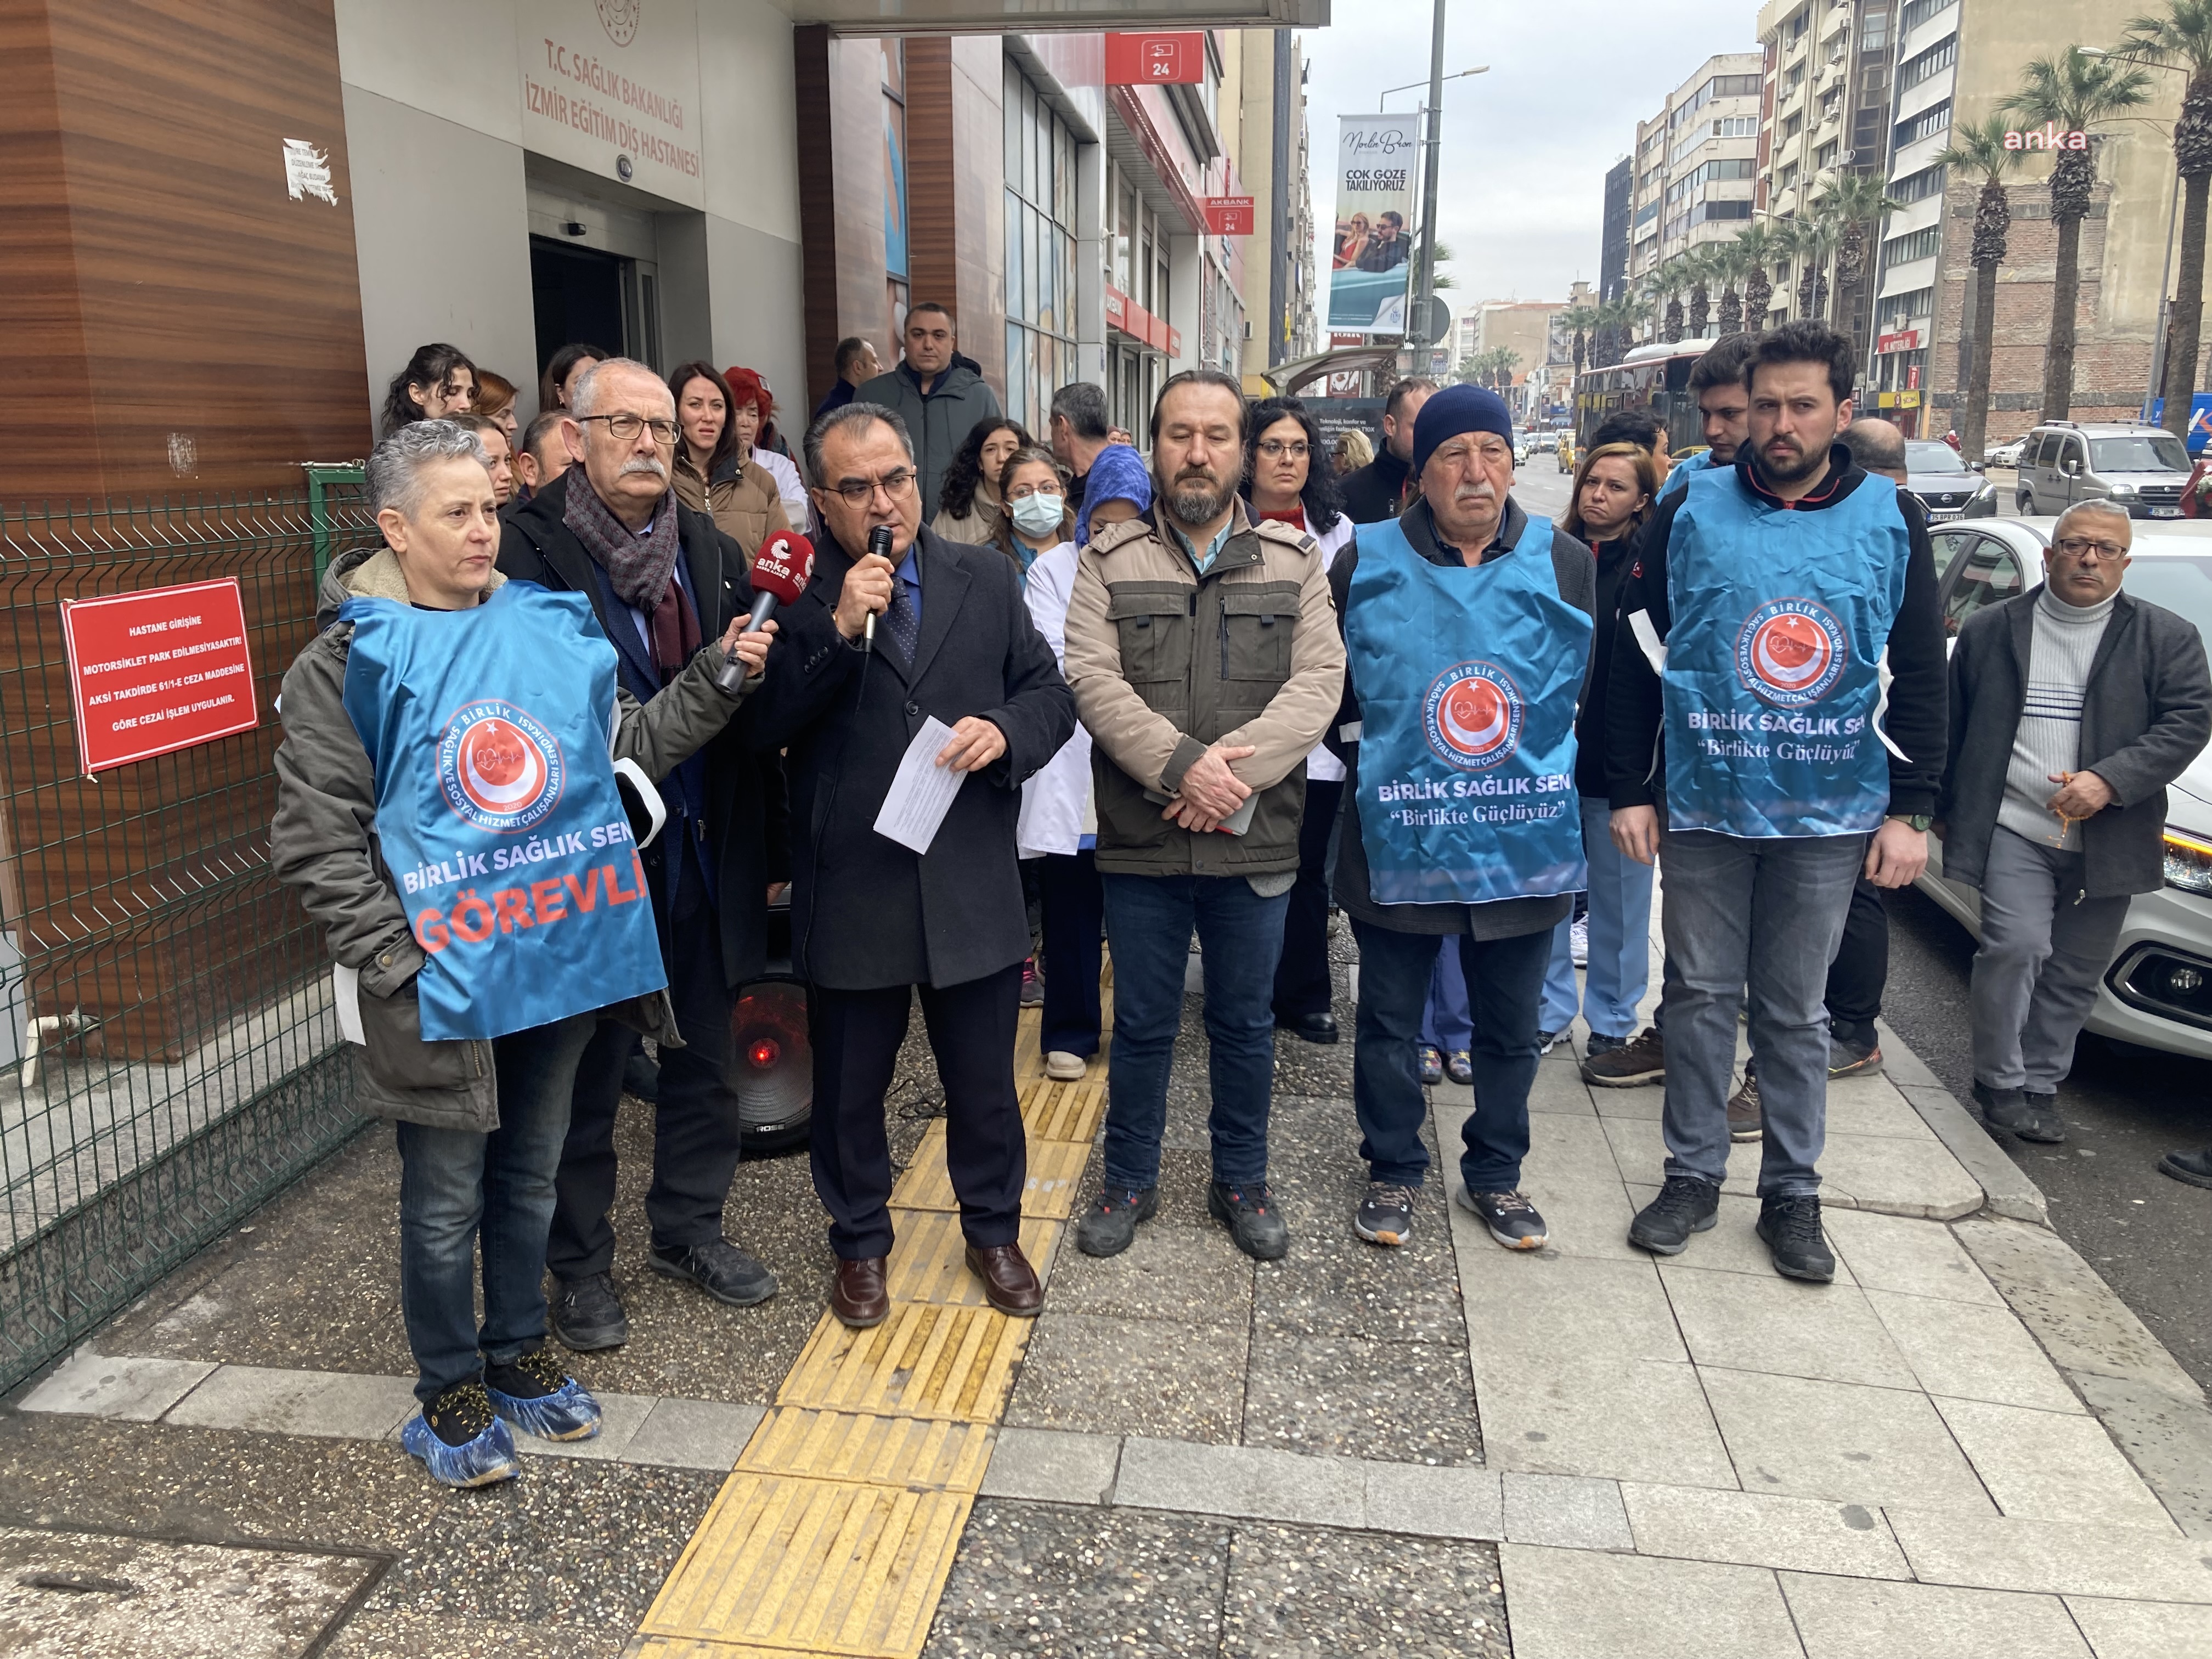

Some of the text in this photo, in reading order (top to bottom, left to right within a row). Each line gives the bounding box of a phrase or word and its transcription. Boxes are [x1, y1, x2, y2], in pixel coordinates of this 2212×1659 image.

[545, 38, 683, 131] T.C. SAĞLIK BAKANLIĞI
[1153, 63, 1170, 76] 24
[526, 74, 699, 178] İZMİR EĞİTİM DİŞ HASTANESİ
[1346, 179, 1406, 191] TAKILIYORUZ
[758, 558, 790, 576] anka
[129, 615, 202, 637] HASTANE GİRİŞİNE
[1770, 602, 1819, 618] BİRLİK
[1740, 613, 1764, 646] SAĞLIK
[1822, 616, 1843, 663] SENDİKASI
[83, 655, 147, 676] MOTORSİKLET
[149, 651, 171, 664] PARK
[1449, 665, 1496, 681] BİRLİK
[1740, 657, 1758, 689] SOSYAL
[89, 663, 245, 706] AKSİ TAKDİRDE 61/1-E CEZA MADDESİNE
[1427, 681, 1446, 714] SAĞLIK
[1757, 686, 1791, 702] HİZMET
[1792, 663, 1840, 704] ÇALIŞANLARI
[112, 694, 235, 732] GÖRE CEZAİ İŞLEM UYGULANIR.
[461, 703, 510, 725] BİRLİK
[1499, 678, 1520, 723] SENDİKASI
[1688, 708, 1755, 731] BİRLİK
[1759, 712, 1839, 735] SAĞLIK
[443, 726, 460, 768] SAĞLIK
[518, 716, 558, 765] SENDİKASI
[1427, 725, 1449, 756] SOSYAL
[1481, 724, 1518, 767] ÇALIŞANLARI
[1448, 753, 1480, 766] HİZMET
[447, 783, 477, 821] SOSYAL
[521, 766, 559, 826] ÇALIŞANLARI
[1378, 773, 1571, 802] BİRLİK SAĞLIK SEN
[478, 814, 521, 827] HİZMET
[503, 801, 522, 811] 2020
[403, 850, 489, 895] BİRLİK
[493, 831, 587, 871] SAĞLIK
[414, 848, 647, 954] GÖREVLİ
